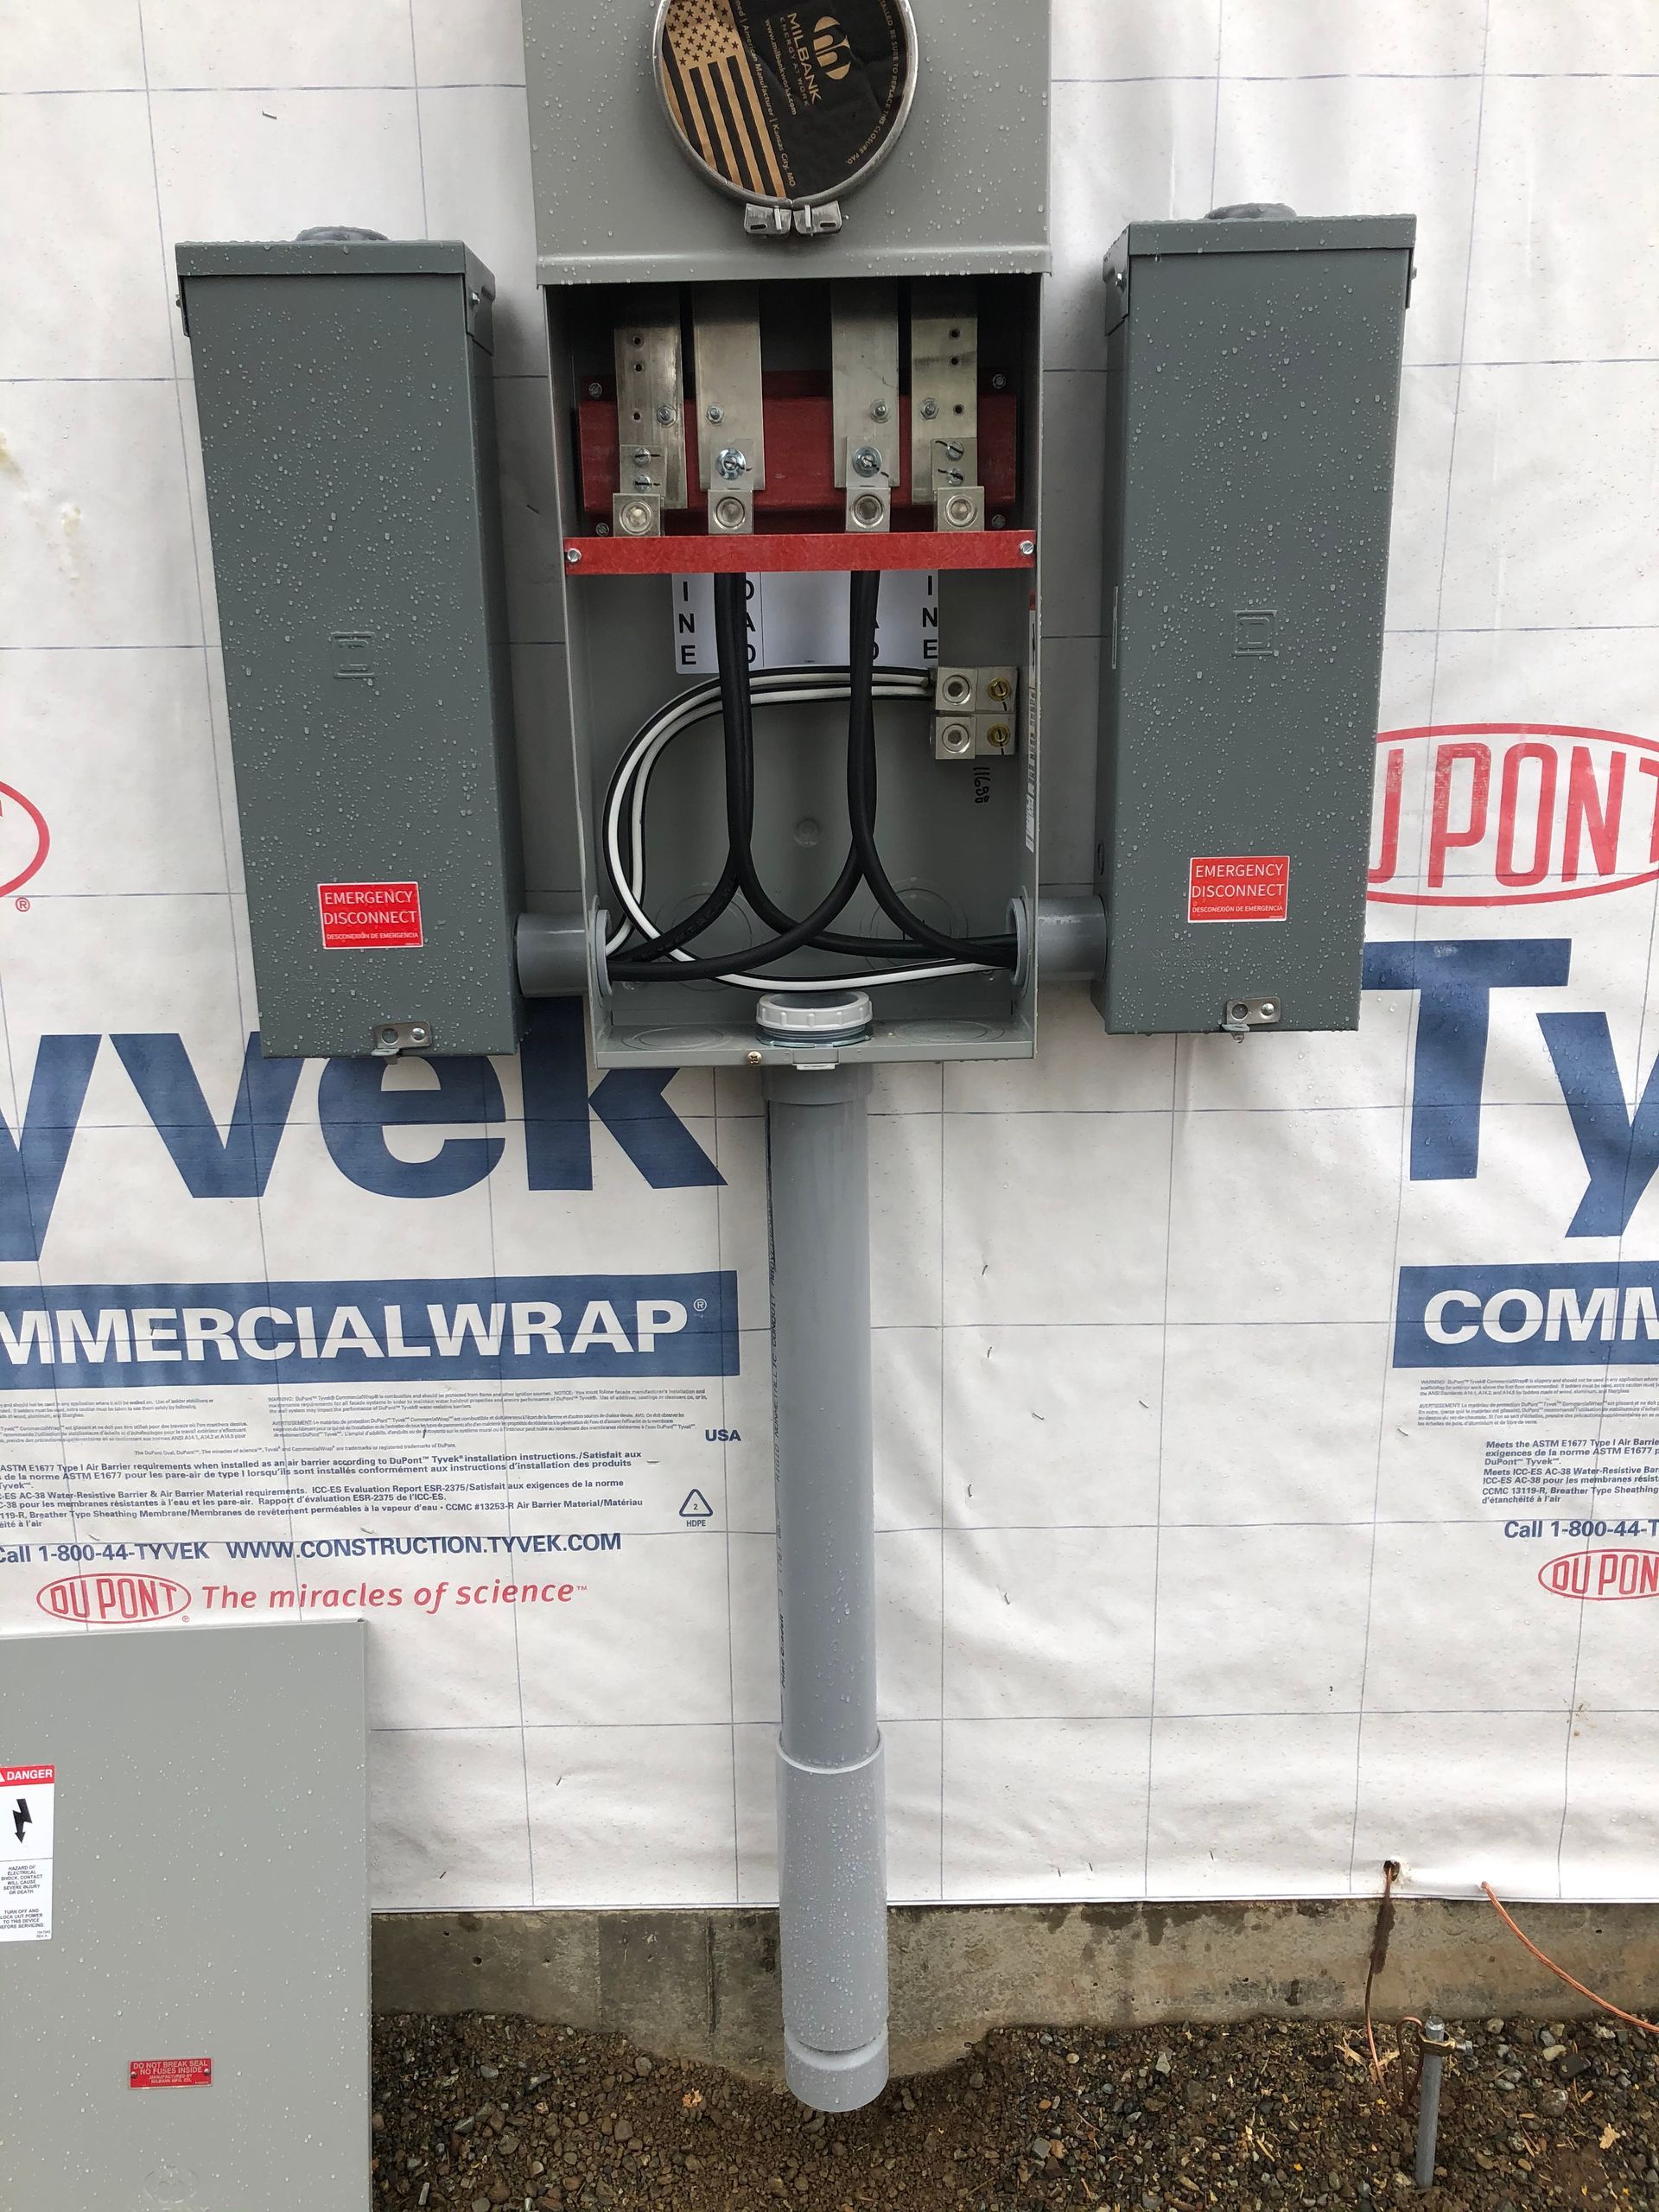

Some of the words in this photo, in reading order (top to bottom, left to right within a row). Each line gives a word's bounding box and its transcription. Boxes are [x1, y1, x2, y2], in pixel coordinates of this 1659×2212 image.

[786, 12, 823, 104] MILBANK
[766, 19, 797, 115] www.milbankworks.com
[892, 63, 899, 73] TO
[798, 77, 810, 106] WORK
[886, 75, 898, 110] REPLACE
[743, 25, 758, 61] American
[755, 63, 774, 117] Manufacturer
[772, 124, 784, 151] Kansas
[786, 172, 796, 187] MO
[858, 125, 881, 155] CLOSURE
[1195, 863, 1284, 877] EMERGENCY
[324, 890, 413, 905] EMERGENCY
[1192, 883, 1285, 898] DISCONNECT
[323, 911, 416, 925] DISCONNECT
[705, 1428, 741, 1442] USA
[1515, 1440, 1530, 1448] the
[1531, 1439, 1560, 1447] ASTM
[1560, 1439, 1587, 1447] E1677
[1588, 1438, 1611, 1448] Type
[1632, 1436, 1659, 1446] Barrie
[55, 1463, 79, 1473] Type
[99, 1462, 131, 1471] Barrier
[132, 1461, 192, 1471] requirements
[193, 1461, 219, 1470] when
[219, 1459, 259, 1469] installed
[300, 1458, 332, 1466] barrier
[332, 1457, 376, 1468] according
[463, 1453, 518, 1462] installation
[1482, 1467, 1510, 1476] Meets
[1511, 1467, 1542, 1476] ICC-ES
[1543, 1467, 1572, 1476] AC-38
[1572, 1465, 1642, 1474] Water-Resistive
[1481, 1486, 1509, 1496] CCMC
[1510, 1486, 1548, 1496] 13119-R,
[1549, 1485, 1589, 1495] Breather
[1589, 1484, 1612, 1495] Type
[28, 1510, 67, 1519] Breather
[68, 1510, 91, 1520] Type
[92, 1509, 137, 1520] Sheathing
[138, 1508, 243, 1517] Membrane/Membranes
[257, 1505, 308, 1516] revêtement
[309, 1504, 362, 1515] perméables
[444, 1503, 473, 1511] CCMC
[474, 1500, 514, 1510] #13253-R
[531, 1500, 562, 1509] Barrier
[563, 1497, 643, 1508] Material/Matériau
[686, 1519, 707, 1528] HDPE
[1504, 1520, 1543, 1538] Call
[38, 1541, 209, 1563] 1-800-44-TYVEK
[226, 1532, 622, 1559] WWW.CONSTRUCTION.TYVEK.COM
[202, 1585, 257, 1609] The
[270, 1582, 403, 1607] miracles
[414, 1581, 449, 1615] of
[6, 1769, 53, 1781] DANGER
